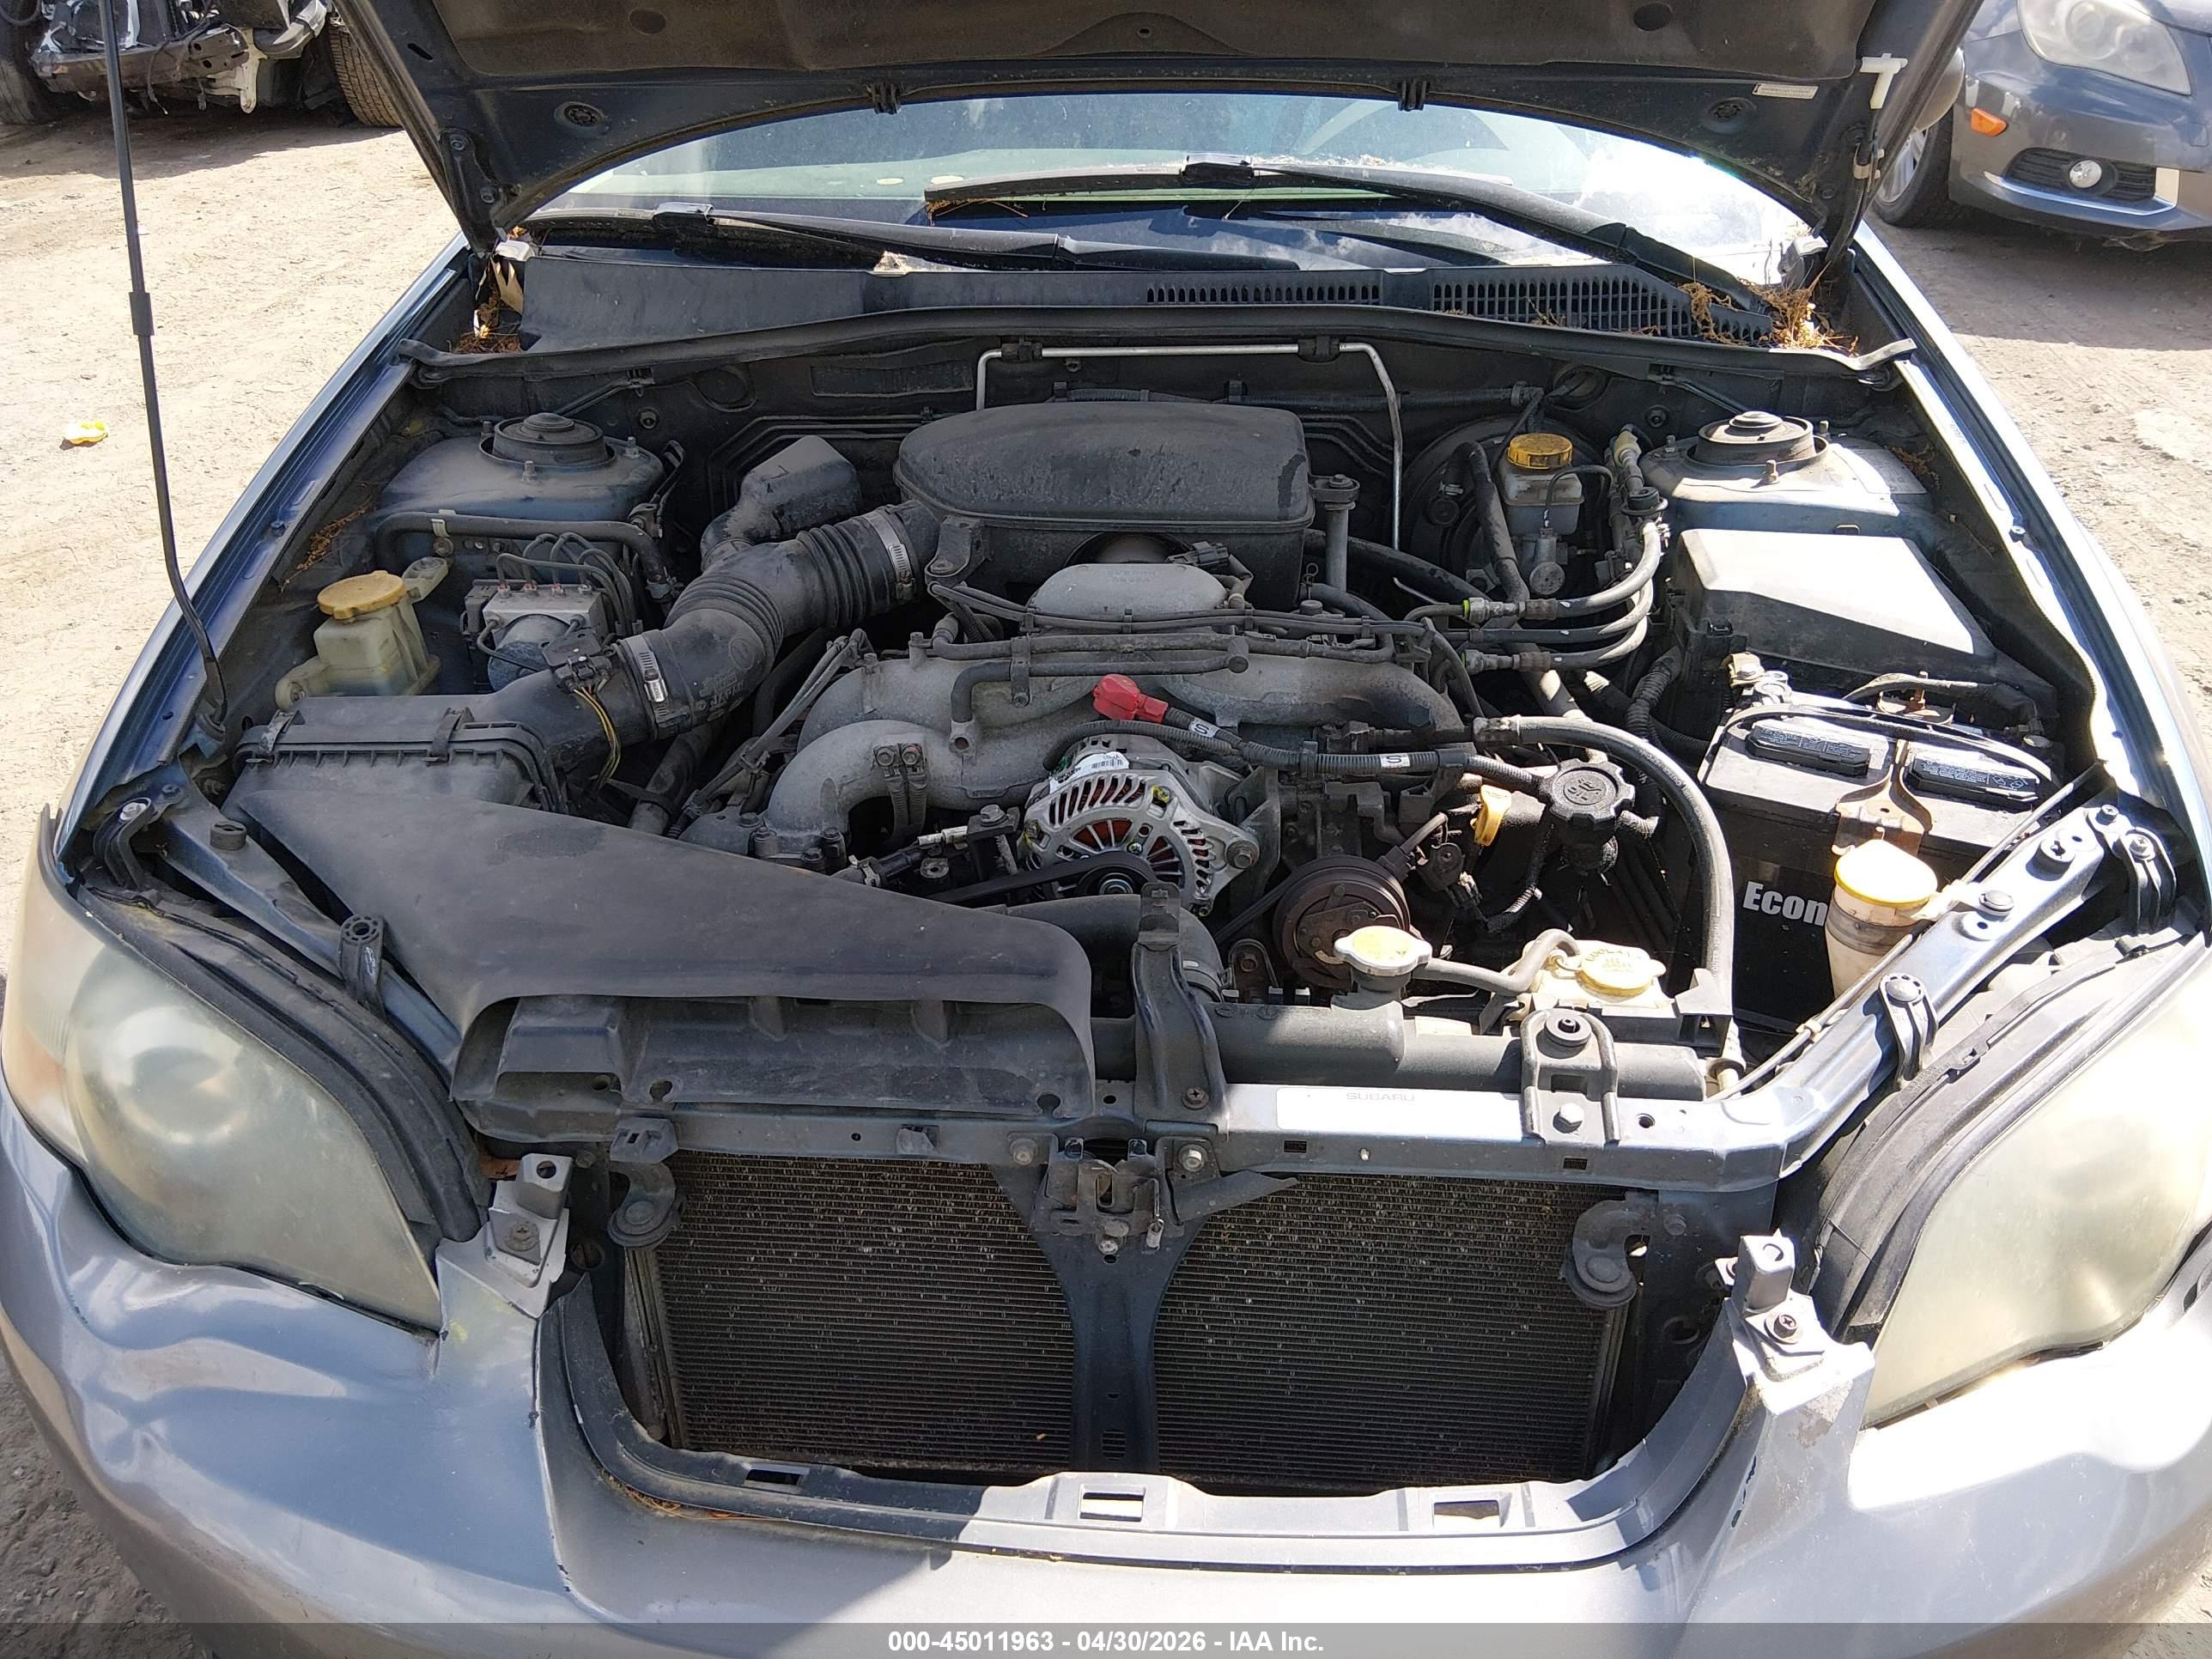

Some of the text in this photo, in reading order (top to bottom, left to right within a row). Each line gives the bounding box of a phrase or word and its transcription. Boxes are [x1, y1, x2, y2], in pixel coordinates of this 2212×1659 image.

[1194, 723, 1209, 735] S
[1386, 755, 1402, 763] S
[1742, 880, 1828, 927] Econ
[1346, 1091, 1416, 1102] SUBARU
